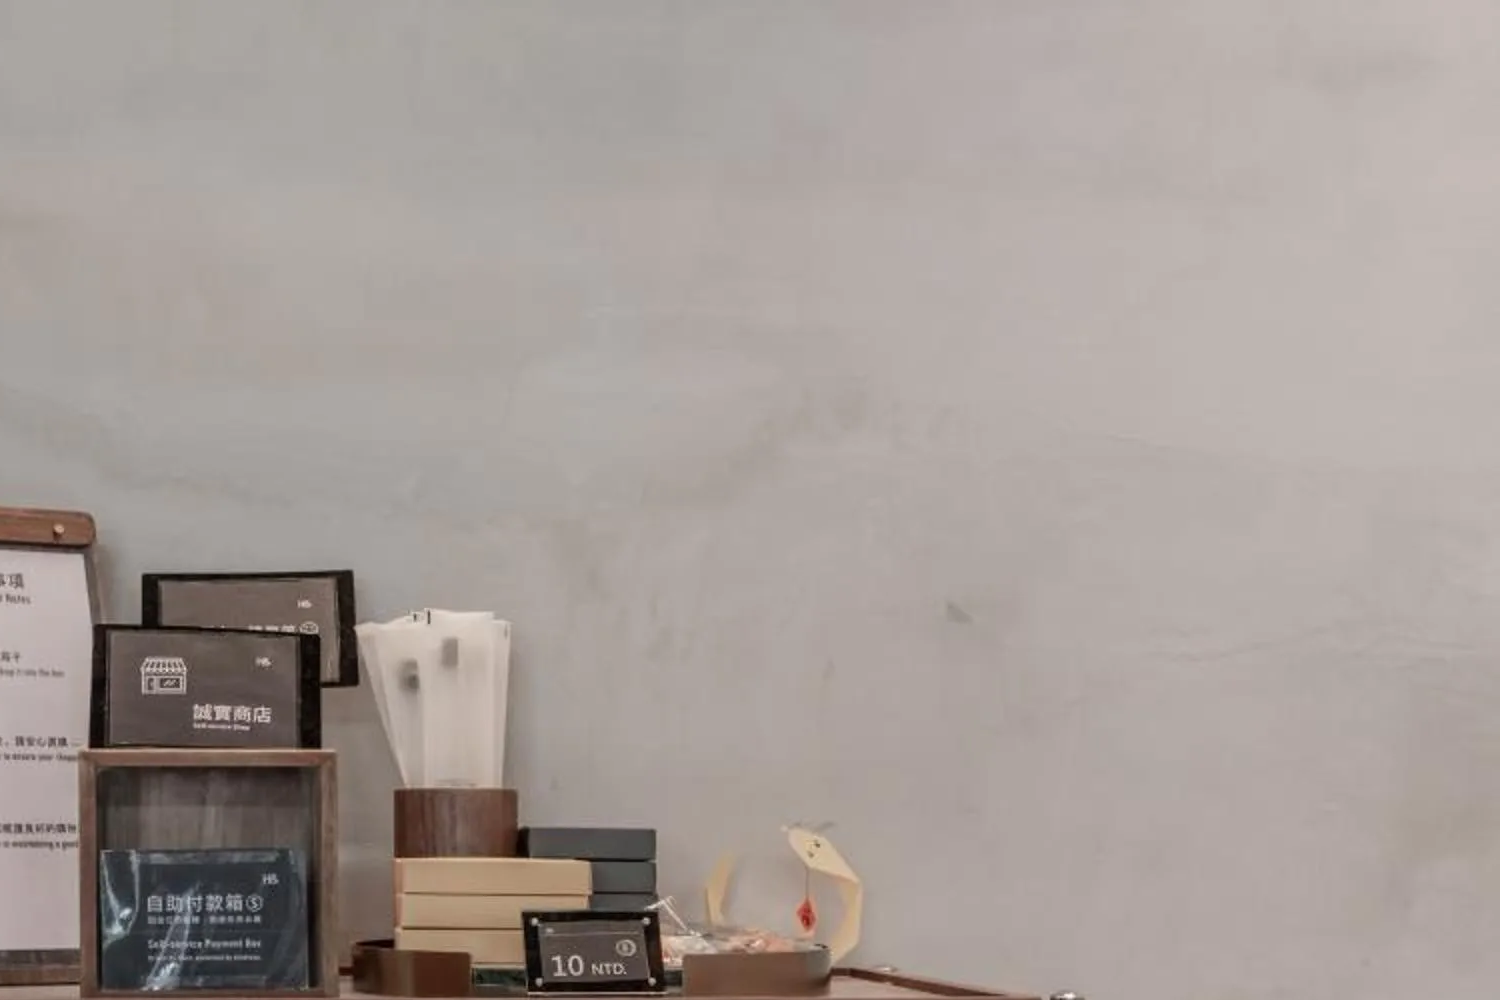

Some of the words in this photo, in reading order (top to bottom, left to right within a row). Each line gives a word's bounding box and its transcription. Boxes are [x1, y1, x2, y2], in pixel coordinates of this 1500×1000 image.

[193, 702, 272, 724] 誠實商店
[147, 893, 243, 912] 自助付款箱
[552, 953, 585, 977] 10
